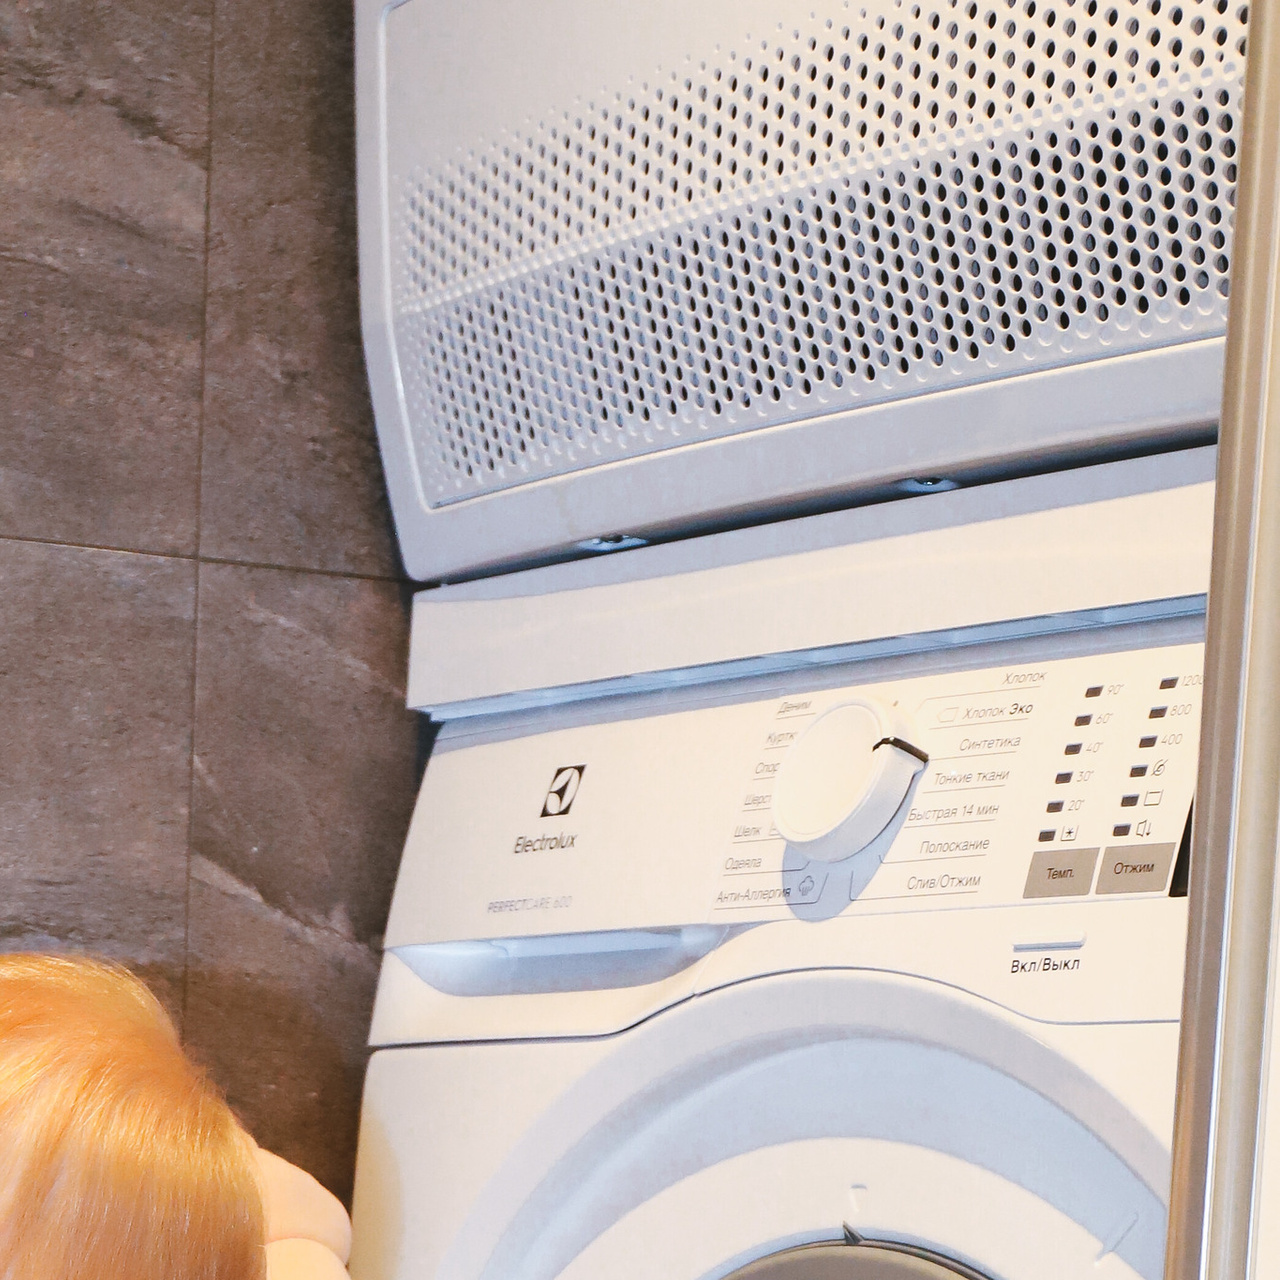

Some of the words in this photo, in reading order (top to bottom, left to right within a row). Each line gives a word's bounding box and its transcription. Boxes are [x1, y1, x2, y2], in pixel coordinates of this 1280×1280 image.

[1002, 671, 1048, 685] Хлопок
[962, 706, 1007, 719] Хлопок
[1008, 702, 1034, 716] Эко
[1170, 703, 1192, 716] 800
[959, 735, 1022, 751] Синтетика
[1160, 733, 1183, 746] 400
[934, 772, 973, 785] Тонкие
[976, 770, 1010, 781] ткани
[908, 807, 958, 822] Быстрая
[962, 804, 974, 816] 14
[976, 804, 1000, 816] мин
[513, 831, 579, 854] Electrolux
[919, 839, 991, 854] Полоскание
[724, 857, 762, 871] Одеяла
[1113, 861, 1156, 875] Отжим
[907, 873, 981, 890] Слив/Отжим
[716, 886, 792, 904] Анти-Аллергия
[1010, 957, 1081, 974] Вкл/Выкл
